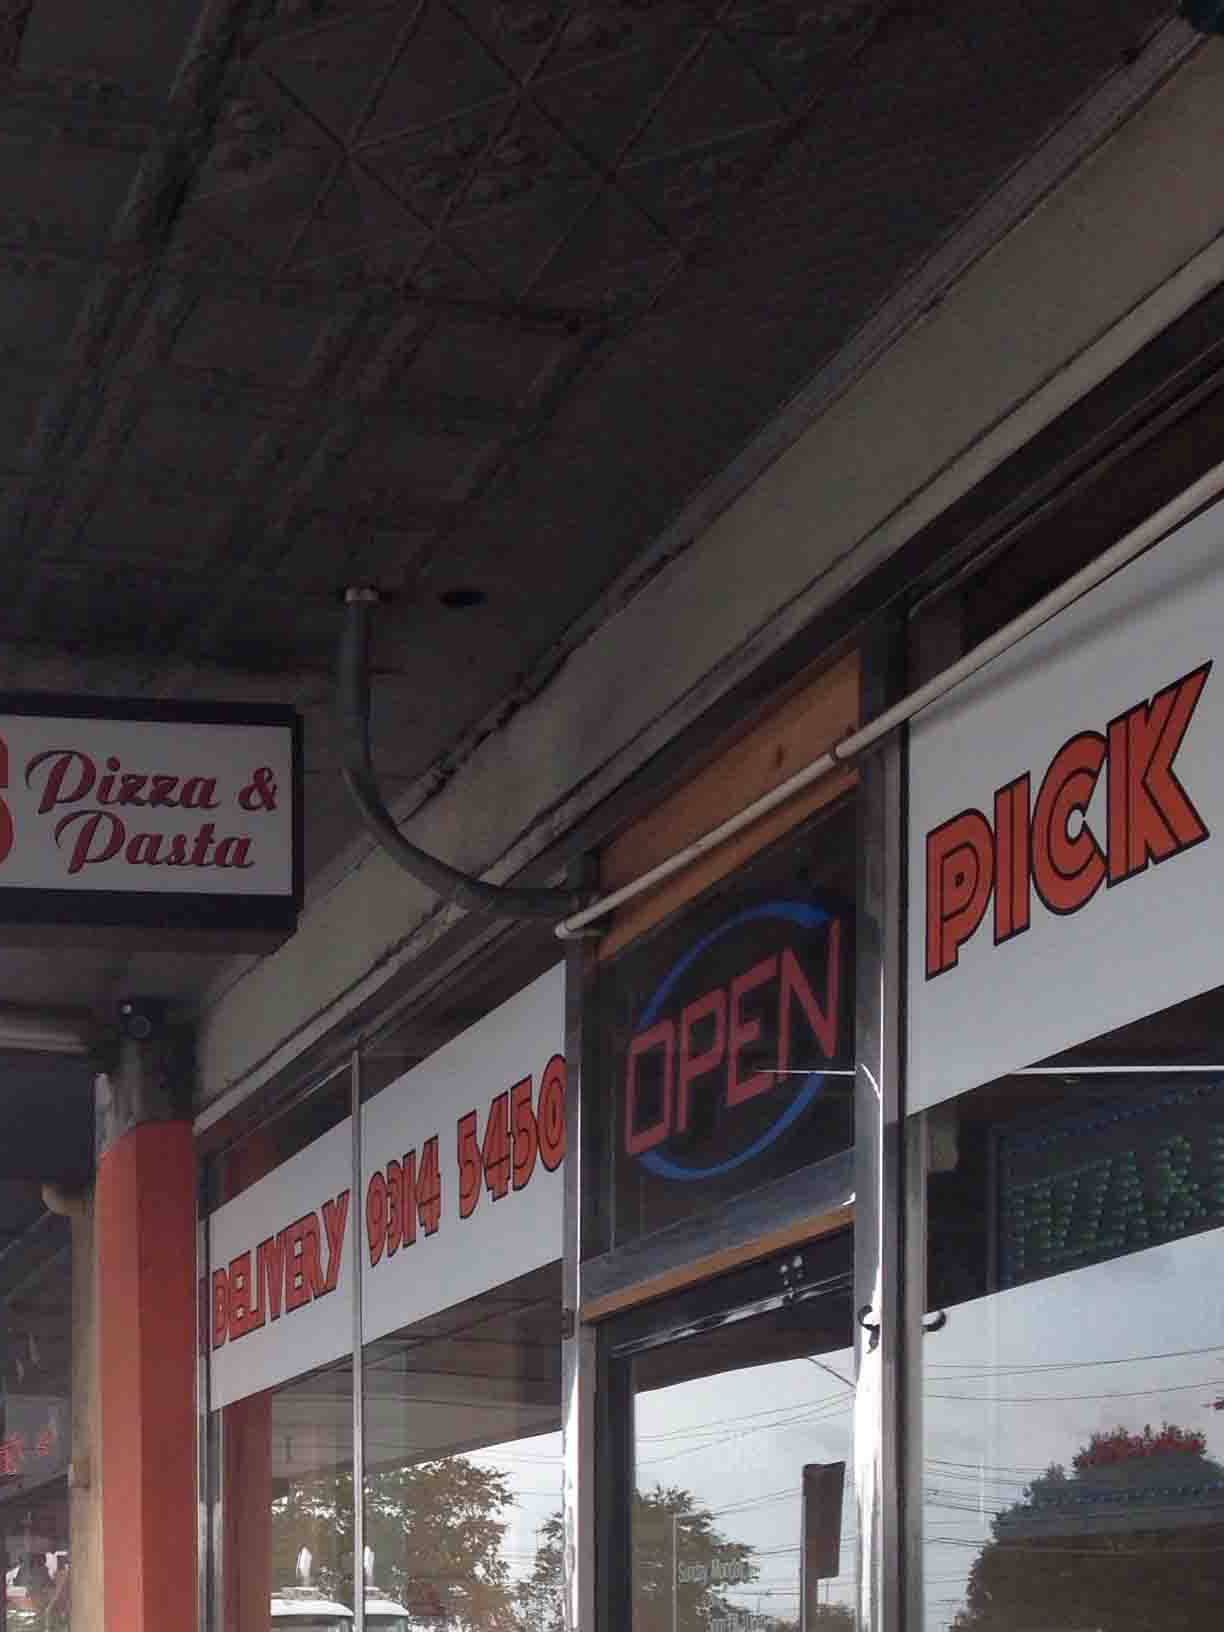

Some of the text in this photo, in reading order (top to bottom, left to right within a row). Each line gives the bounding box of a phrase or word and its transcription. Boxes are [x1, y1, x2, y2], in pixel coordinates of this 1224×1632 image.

[24, 749, 278, 815] Pizza &
[55, 809, 255, 874] Pasta
[925, 660, 1213, 981] PICK
[625, 918, 841, 1155] OPEN
[212, 1054, 568, 1352] DELIVERY 9314 5450
